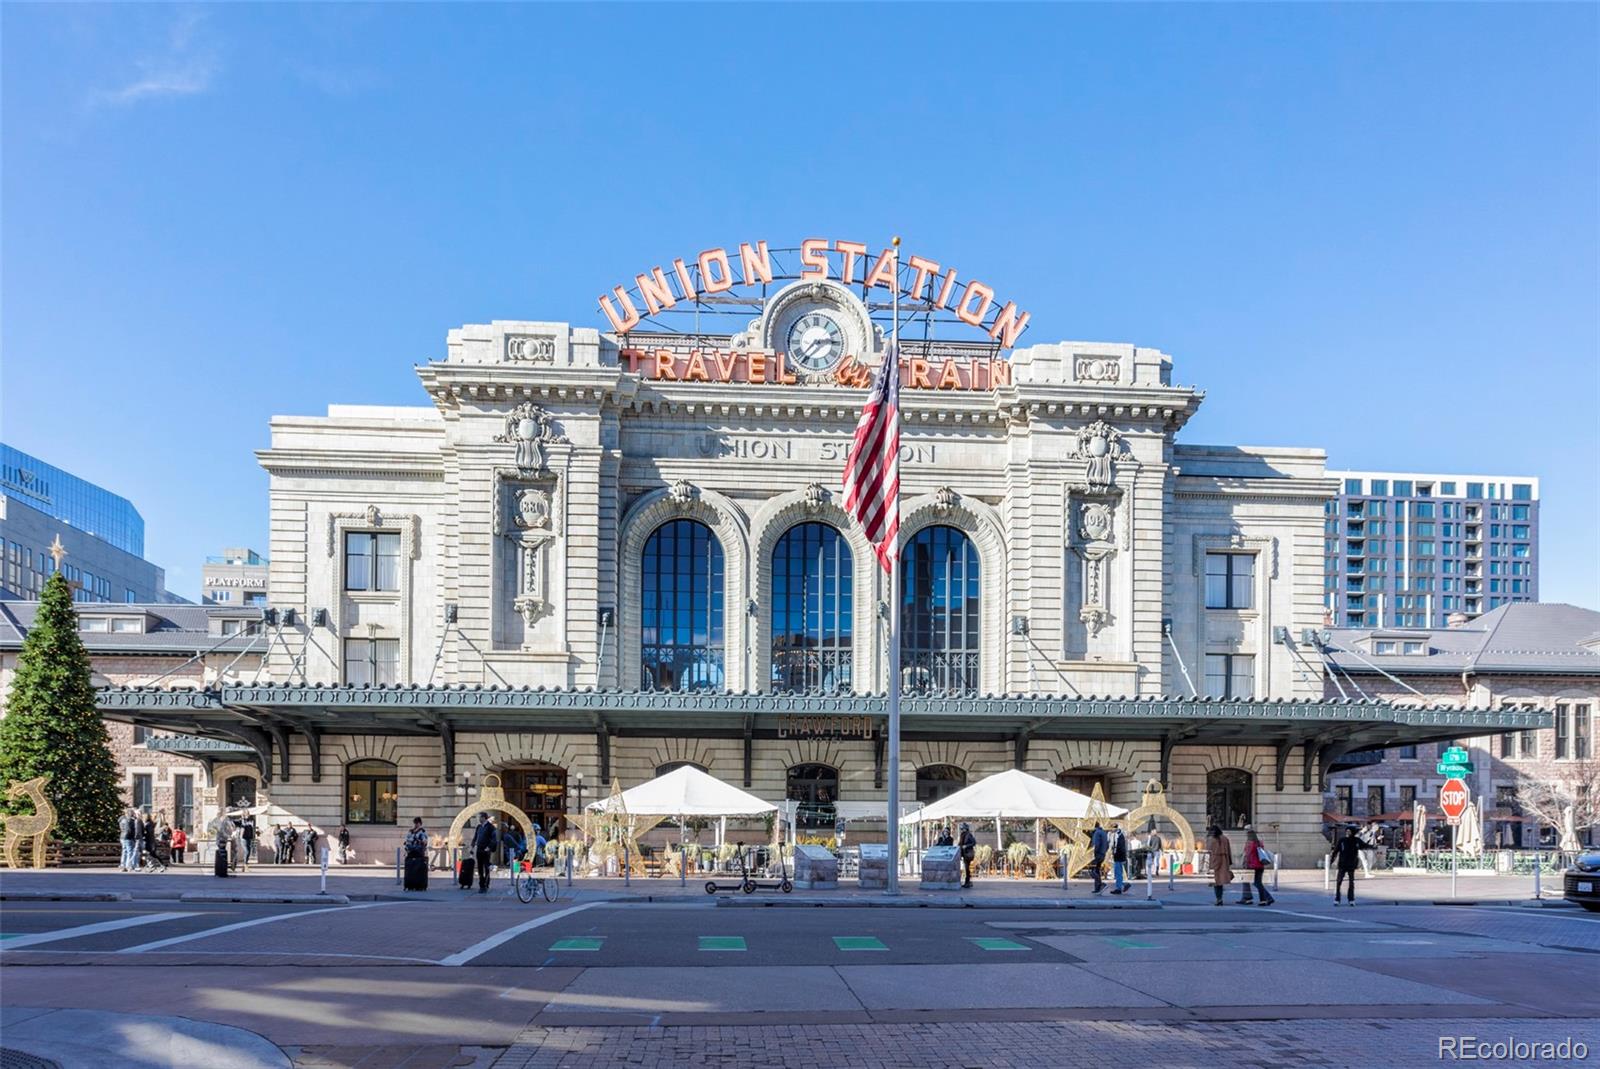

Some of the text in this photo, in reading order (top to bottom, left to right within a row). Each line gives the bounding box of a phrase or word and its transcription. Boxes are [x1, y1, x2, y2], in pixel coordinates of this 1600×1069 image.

[599, 238, 1031, 349] UNION STATION
[621, 349, 1011, 392] TRAVEL by RAIN
[696, 436, 936, 463] UNION STON
[205, 576, 266, 588] PLATFORM
[777, 716, 873, 739] CRAWFORD
[1442, 791, 1465, 805] STOP
